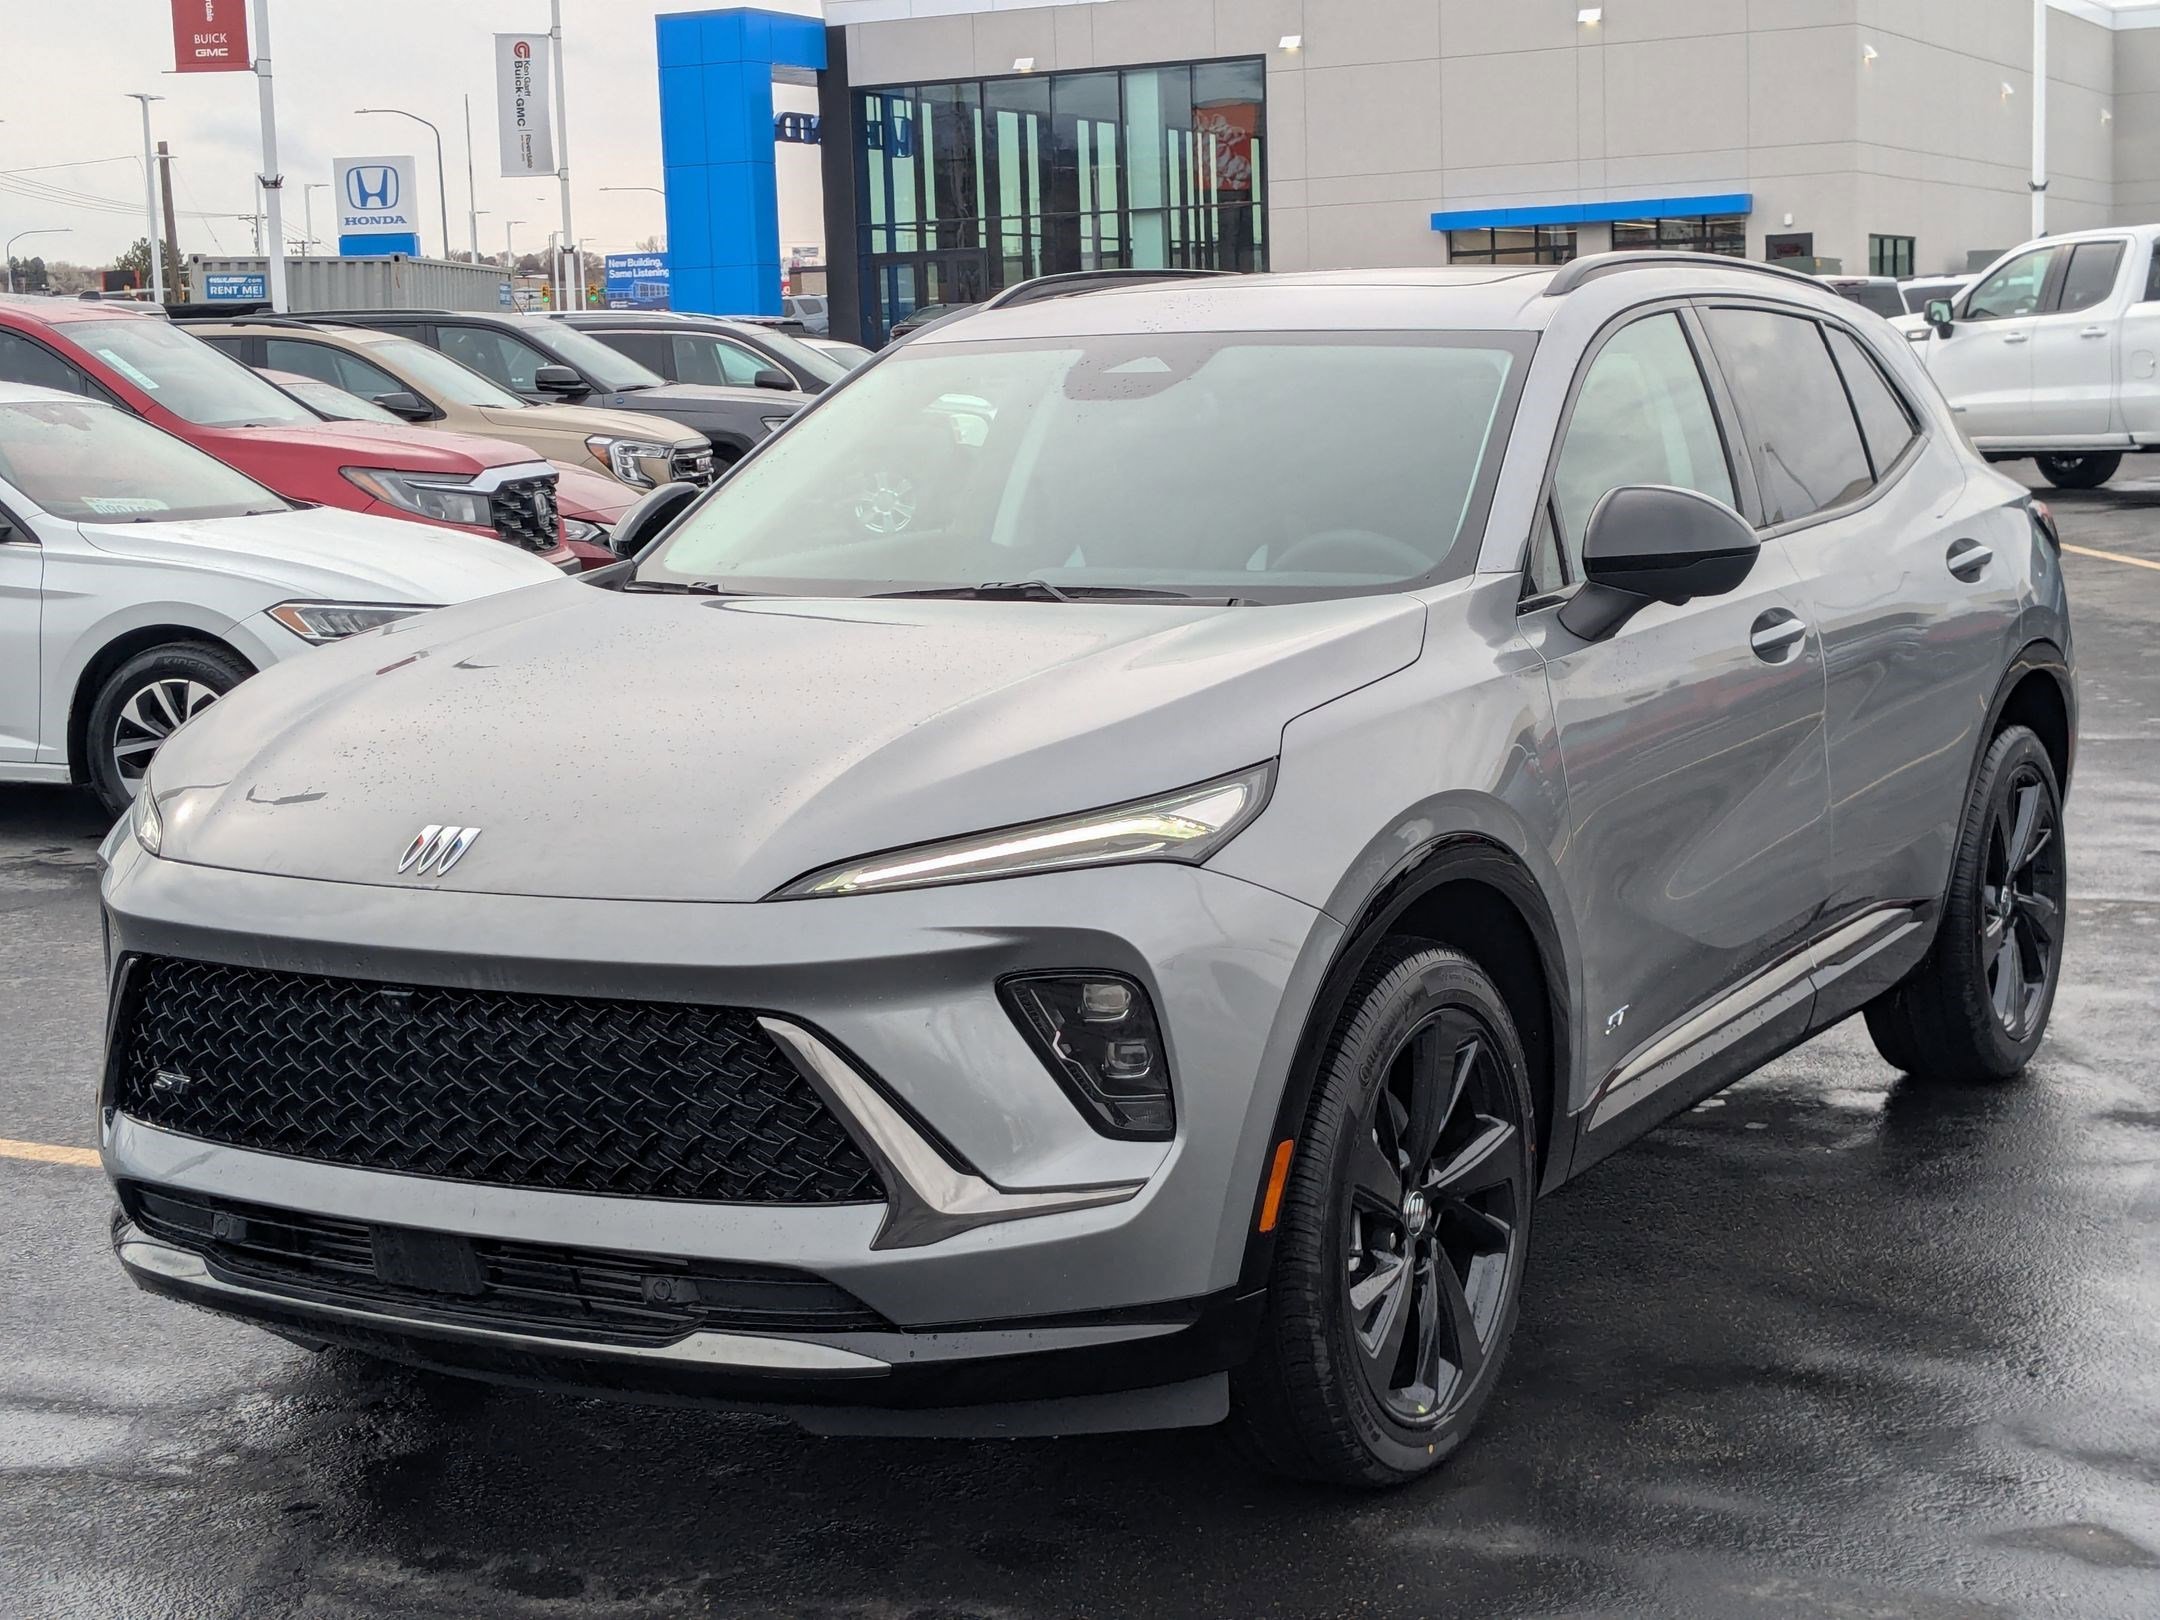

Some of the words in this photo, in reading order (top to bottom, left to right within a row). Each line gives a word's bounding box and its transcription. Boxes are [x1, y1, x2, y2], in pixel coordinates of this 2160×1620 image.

[194, 33, 227, 44] BUICK
[195, 48, 228, 57] GMC
[523, 60, 531, 76] Ken
[344, 215, 408, 226] HONDA
[608, 259, 627, 268] New
[627, 257, 663, 269] Building,
[608, 269, 633, 279] Same
[633, 267, 670, 279] Listening
[210, 286, 239, 295] RENT
[242, 285, 263, 295] ME!
